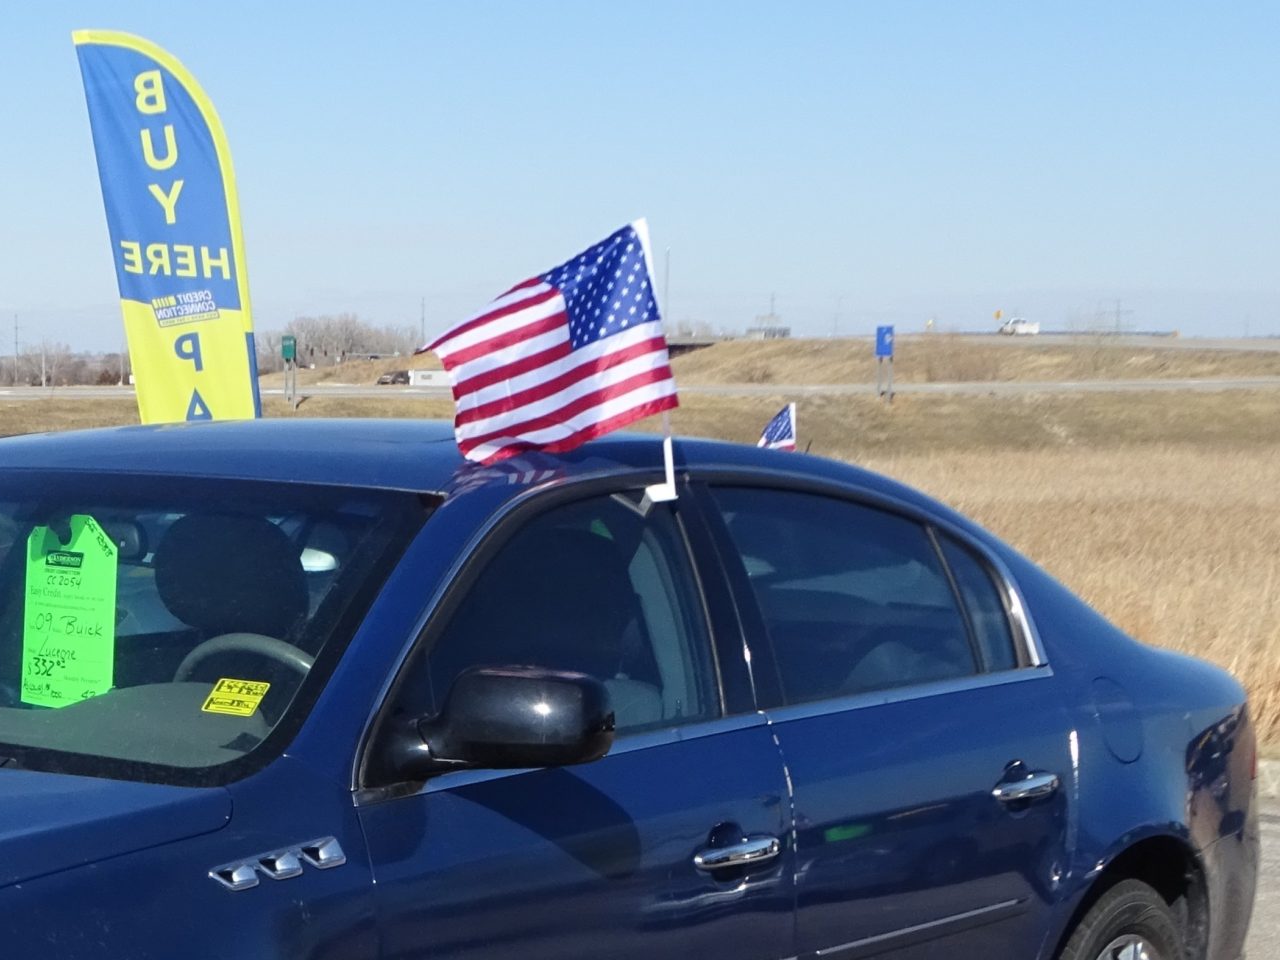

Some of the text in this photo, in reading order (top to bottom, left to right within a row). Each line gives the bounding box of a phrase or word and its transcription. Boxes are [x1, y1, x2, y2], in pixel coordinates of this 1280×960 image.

[47, 575, 81, 590] CC 2054
[43, 586, 61, 598] Credit
[35, 612, 102, 636] 09 Buick
